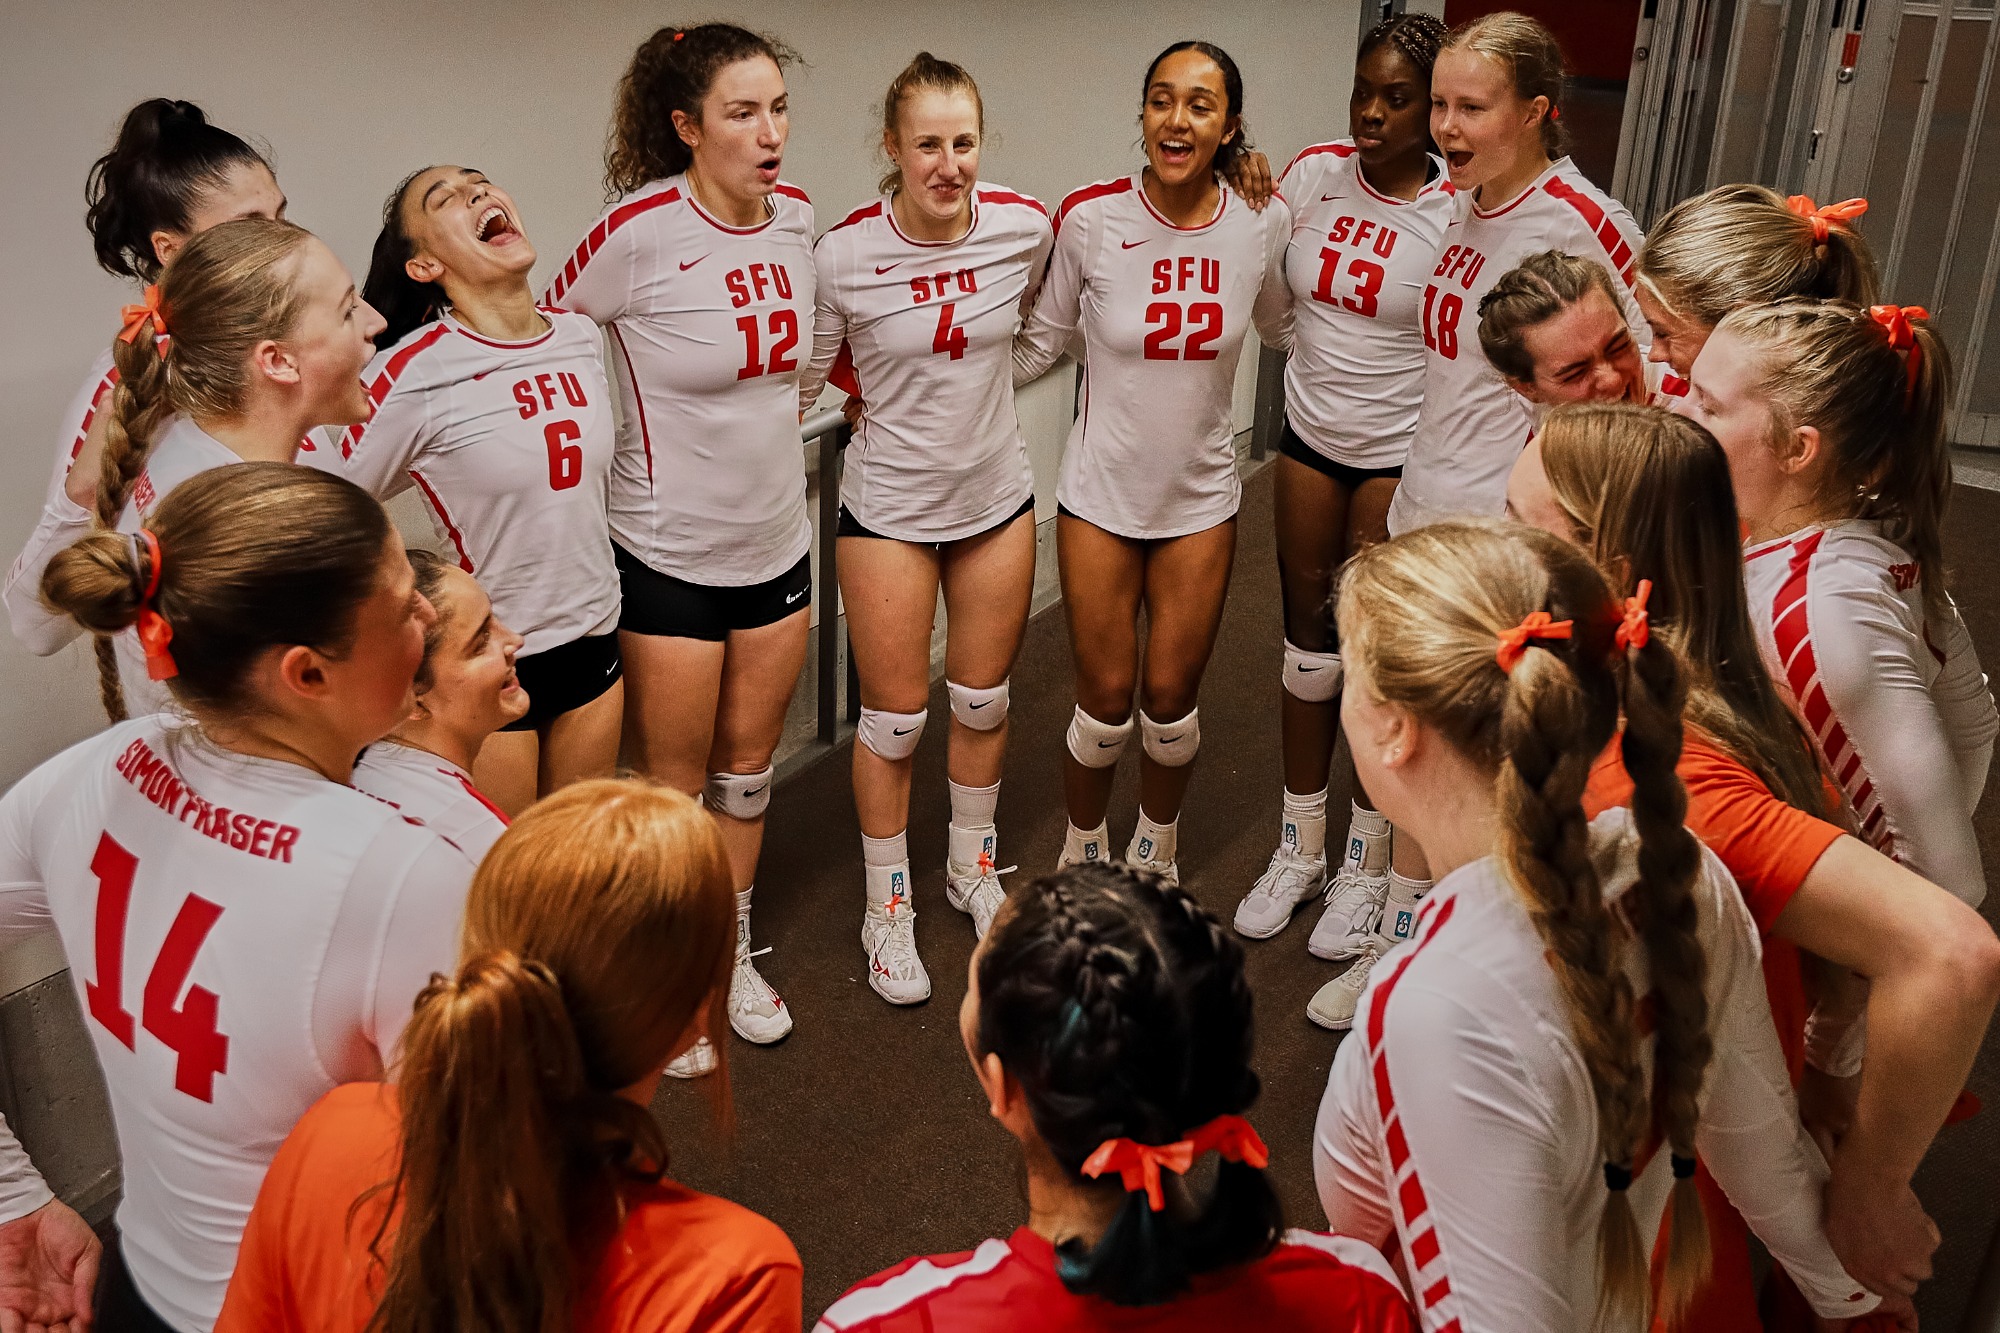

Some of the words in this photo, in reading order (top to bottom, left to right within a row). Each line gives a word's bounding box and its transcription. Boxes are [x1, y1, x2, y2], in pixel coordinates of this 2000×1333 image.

[1328, 215, 1398, 259] SFU
[725, 263, 793, 309] SFU
[910, 268, 978, 304] SFU
[1151, 256, 1220, 295] SFU
[1311, 246, 1385, 318] 13
[1433, 244, 1486, 290] SFU
[736, 309, 799, 381] 12
[932, 302, 968, 361] 4
[1144, 301, 1224, 361] 22
[1423, 284, 1464, 361] 18
[512, 372, 588, 420] SFU
[544, 419, 583, 492] 6
[115, 737, 186, 815] SIMON
[179, 786, 302, 864] FRASER
[85, 829, 229, 1104] 14
